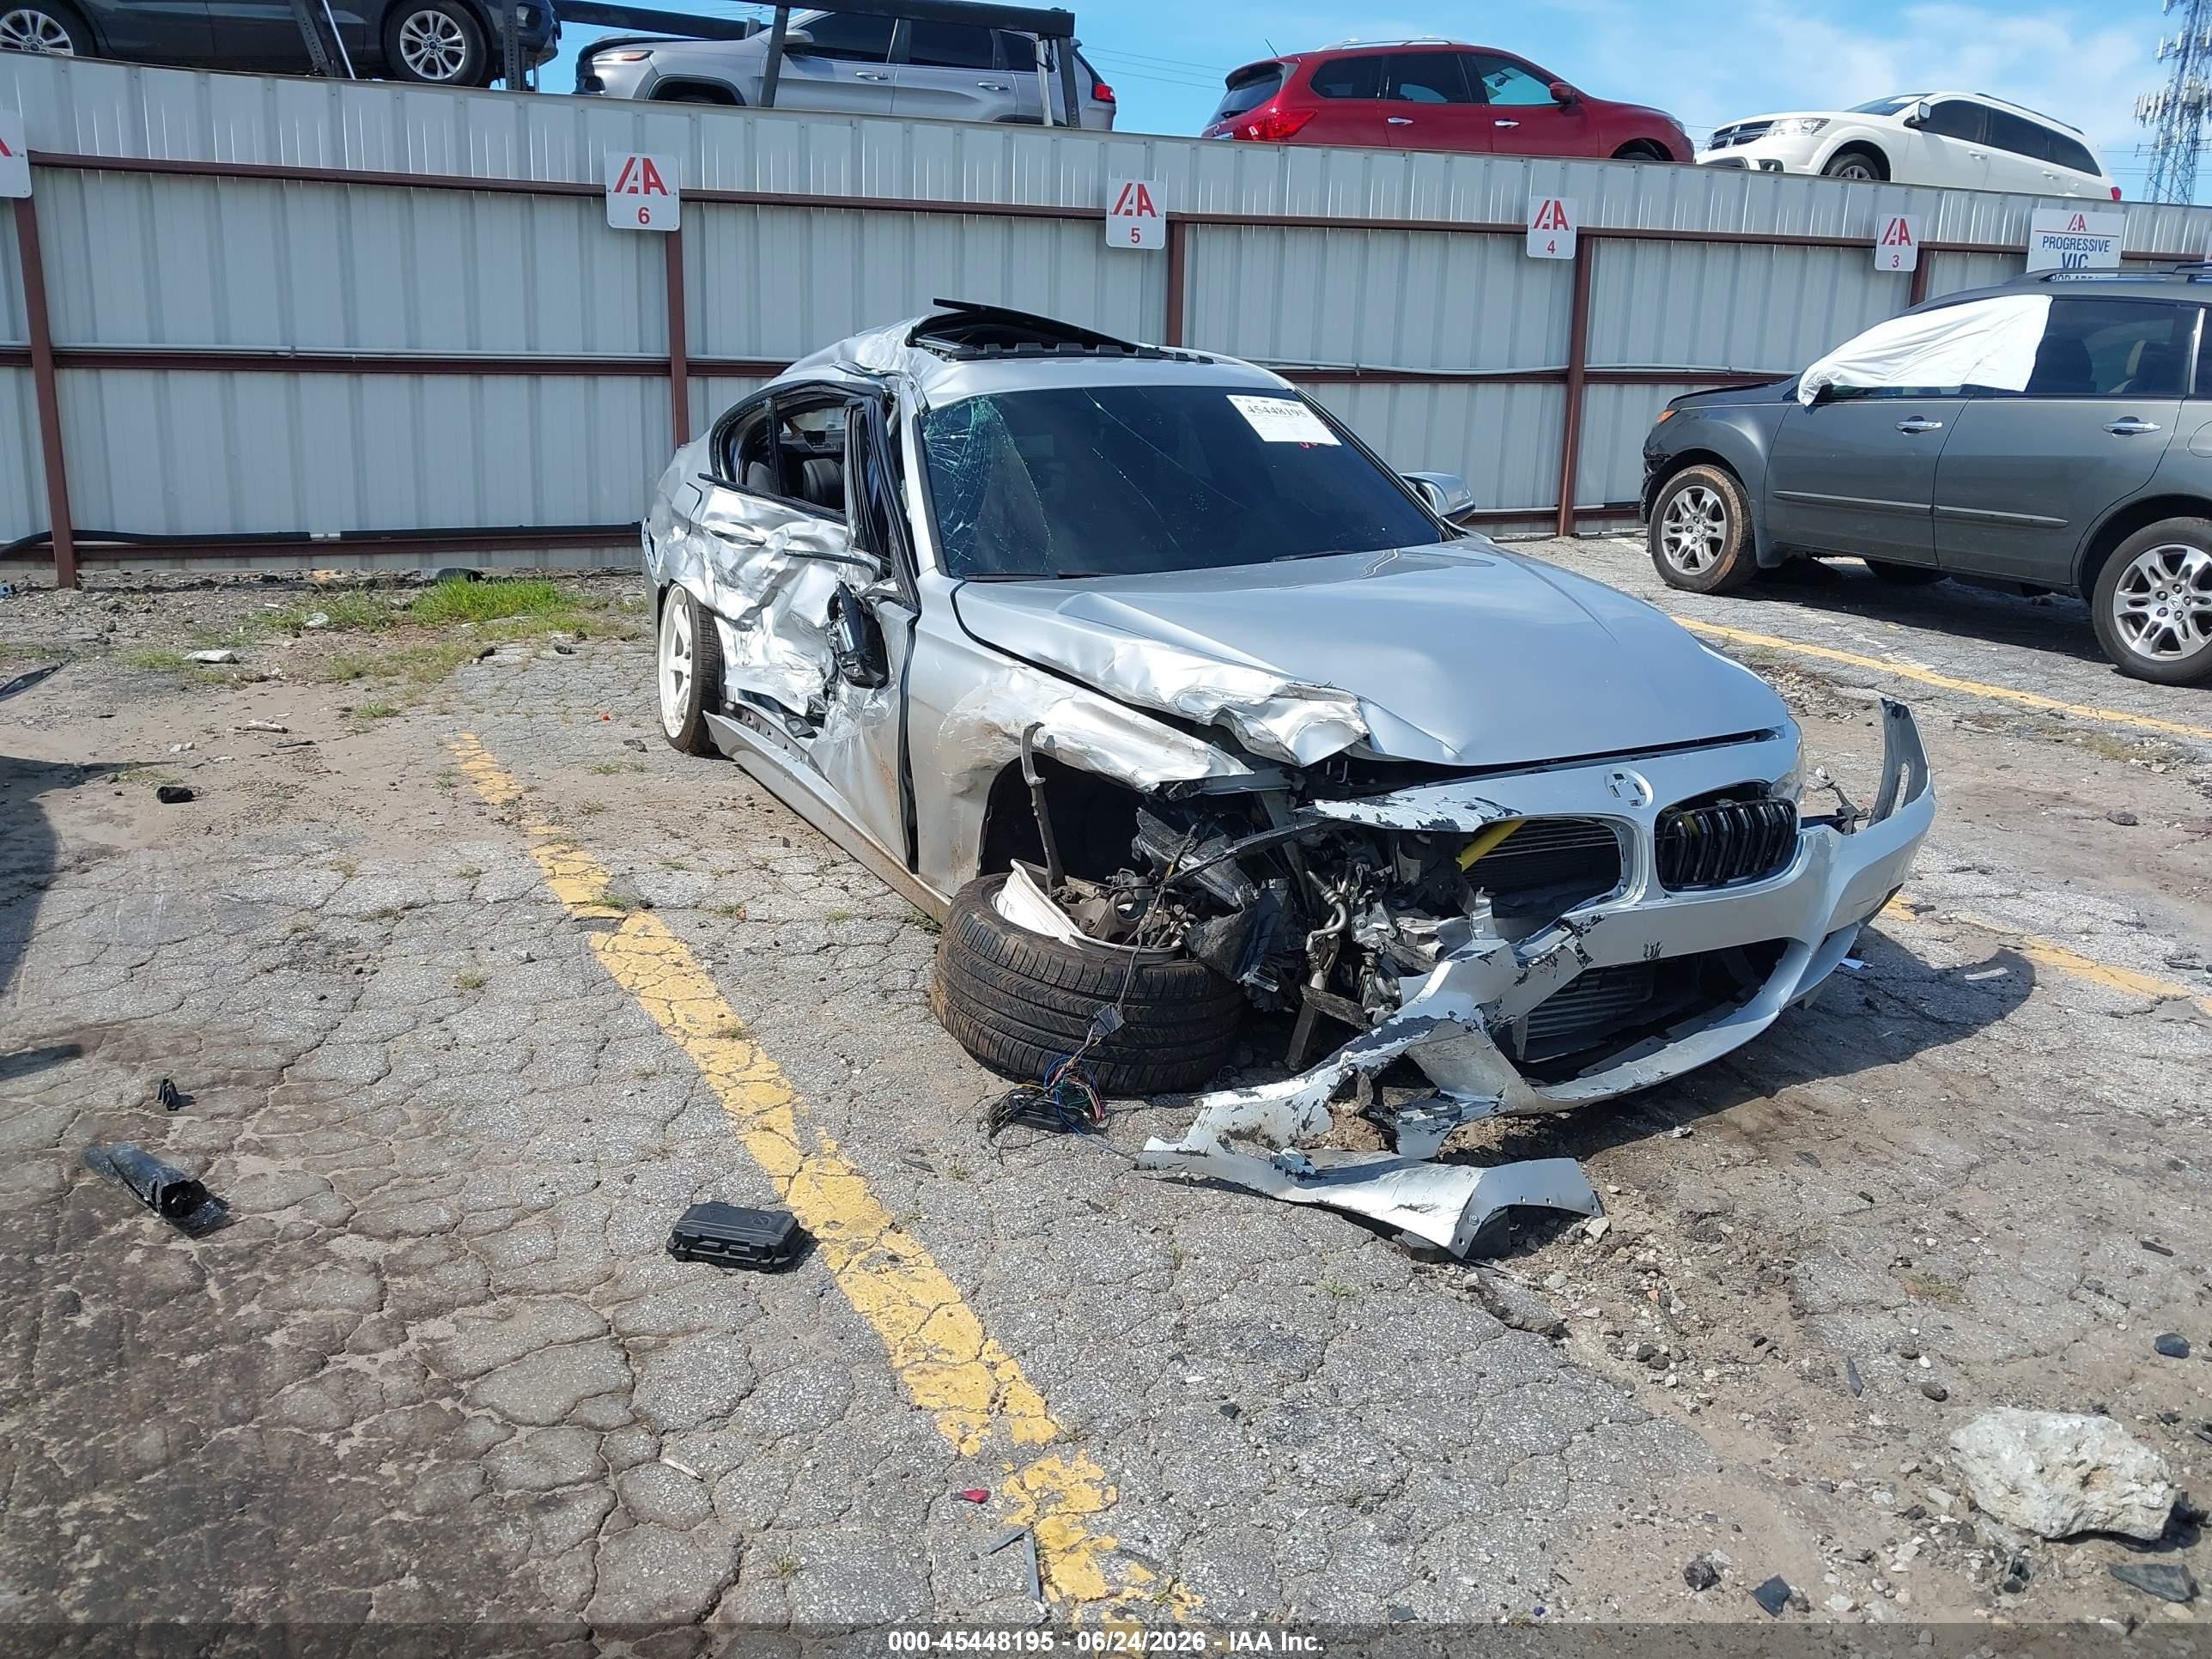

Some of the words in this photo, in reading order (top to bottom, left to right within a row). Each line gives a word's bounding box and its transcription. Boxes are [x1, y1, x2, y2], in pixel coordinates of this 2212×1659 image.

[638, 206, 651, 225] 6
[1131, 227, 1141, 244] 5
[2042, 235, 2111, 252] PROGRESSIVE
[1547, 240, 1557, 255] 4
[1892, 254, 1900, 269] 3
[2061, 252, 2089, 269] VIC
[1247, 404, 1309, 418] 45448195
